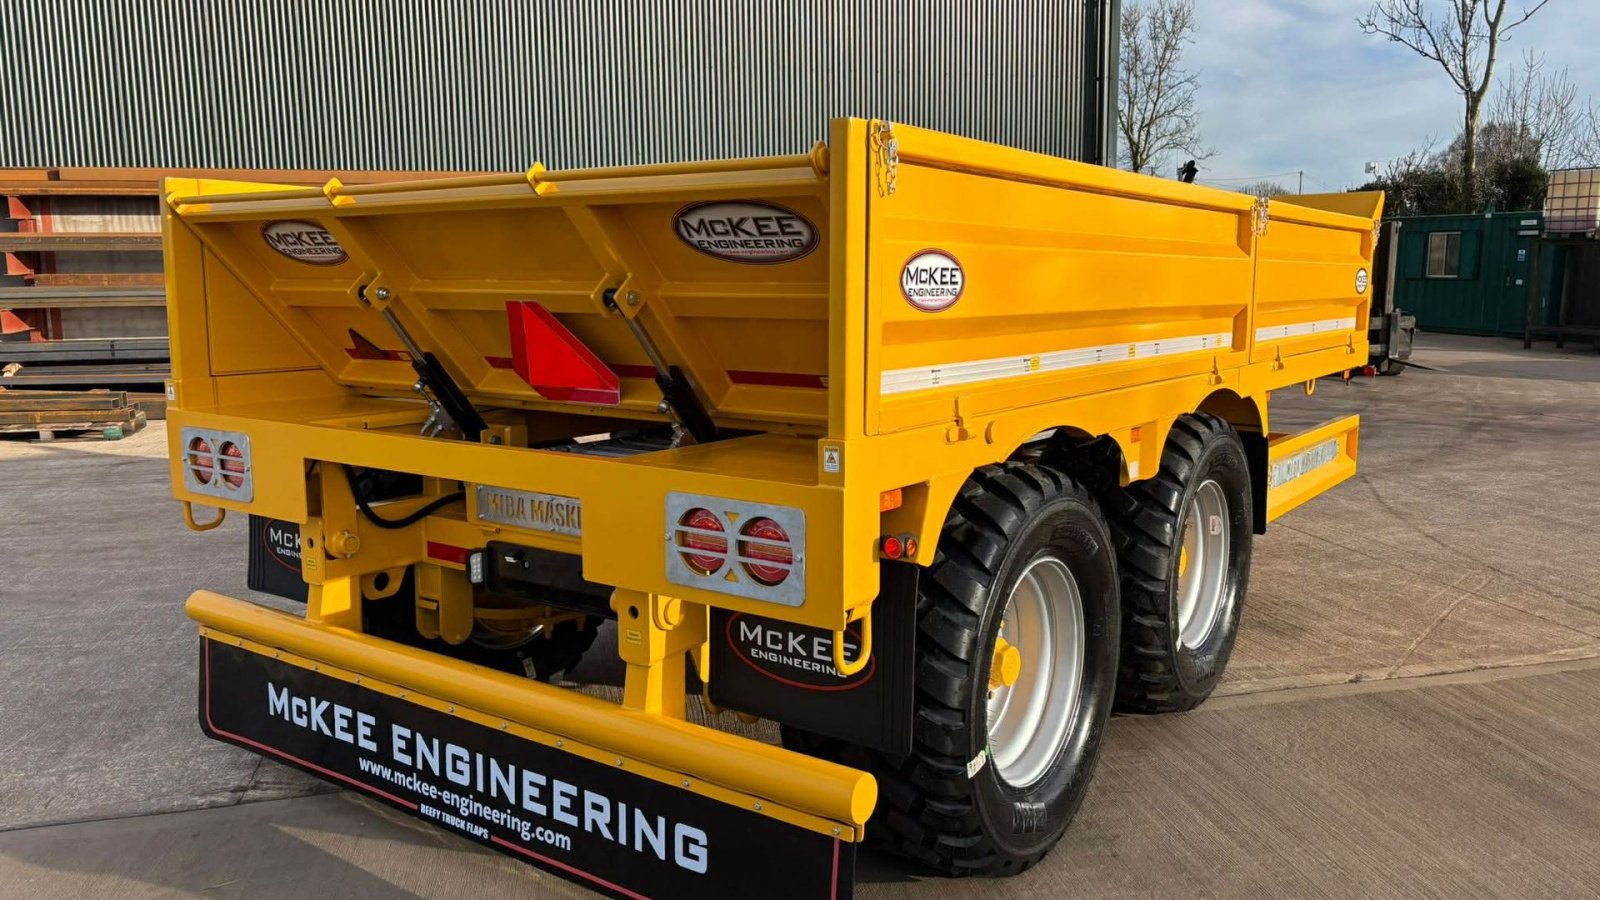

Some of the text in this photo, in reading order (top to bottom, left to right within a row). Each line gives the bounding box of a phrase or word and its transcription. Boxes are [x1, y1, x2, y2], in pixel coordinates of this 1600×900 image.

[698, 238, 804, 250] ENGINEERING
[905, 266, 959, 286] McKEE
[908, 287, 957, 297] ENGINEERING
[486, 492, 527, 521] MIBA
[267, 681, 709, 875] McKEE ENGINEERING
[358, 756, 572, 851] www.mckee-engineering.com
[420, 804, 489, 839] BEEFY TRUCK FLAPS
